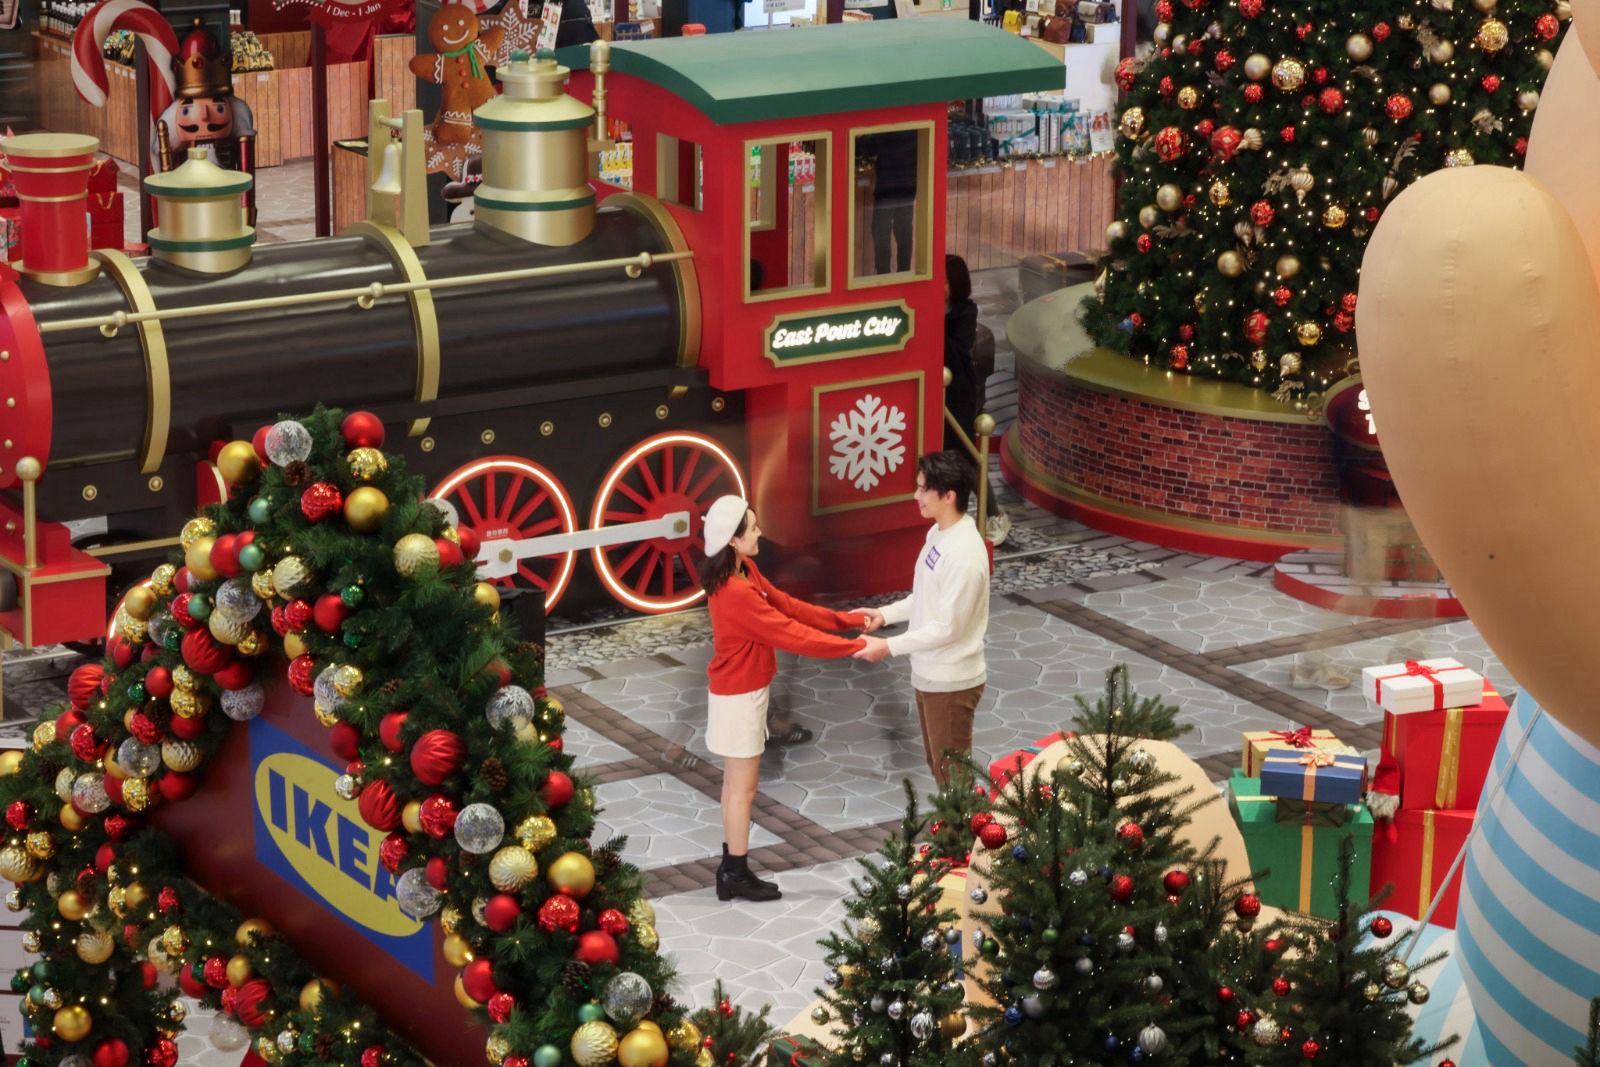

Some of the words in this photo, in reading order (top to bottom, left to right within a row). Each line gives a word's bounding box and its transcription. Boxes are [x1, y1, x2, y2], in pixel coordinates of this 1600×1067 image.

[332, 6, 350, 17] Dec
[365, 3, 381, 15] Jan
[772, 326, 813, 349] East
[814, 320, 862, 344] Point
[864, 316, 901, 336] City
